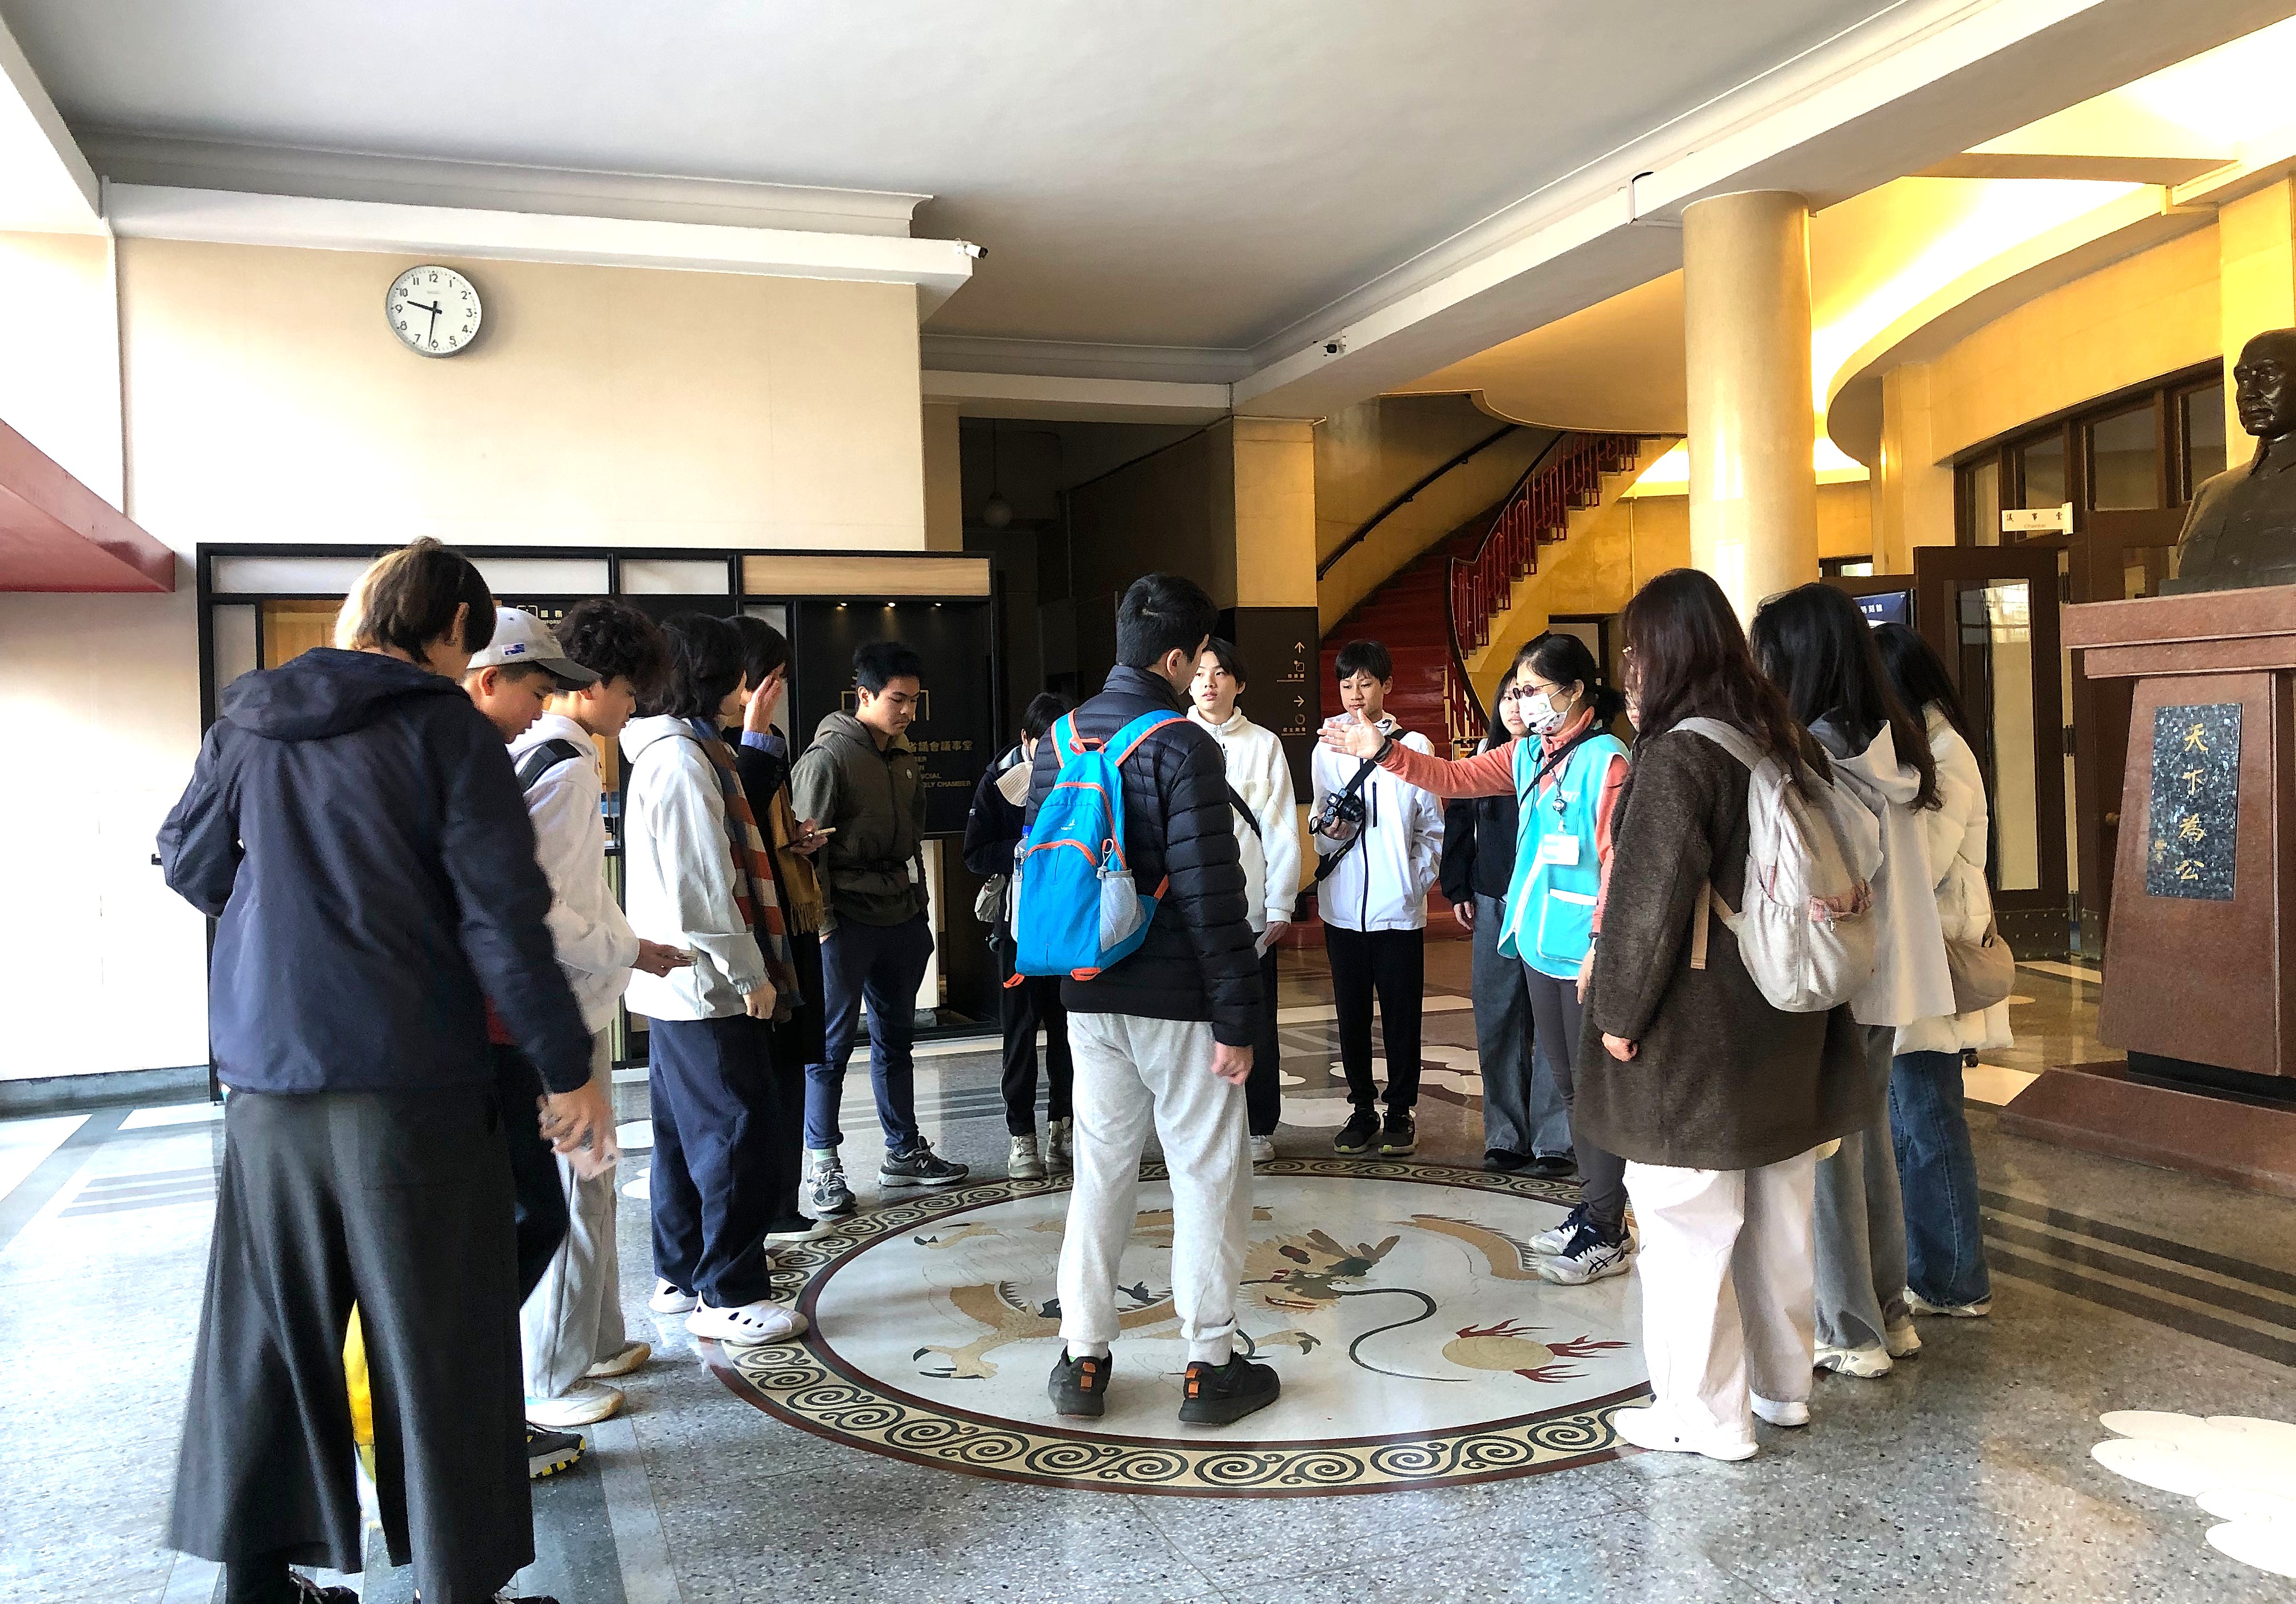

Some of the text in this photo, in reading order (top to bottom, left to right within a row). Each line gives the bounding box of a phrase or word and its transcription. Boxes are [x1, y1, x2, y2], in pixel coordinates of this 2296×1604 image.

[429, 273, 438, 282] 12
[399, 288, 408, 297] 10
[461, 290, 468, 300] 2
[395, 304, 403, 313] 9
[466, 308, 473, 317] 3
[400, 321, 407, 330] 8
[431, 339, 438, 348] 6
[449, 336, 456, 344] 5
[916, 1159, 929, 1168] N
